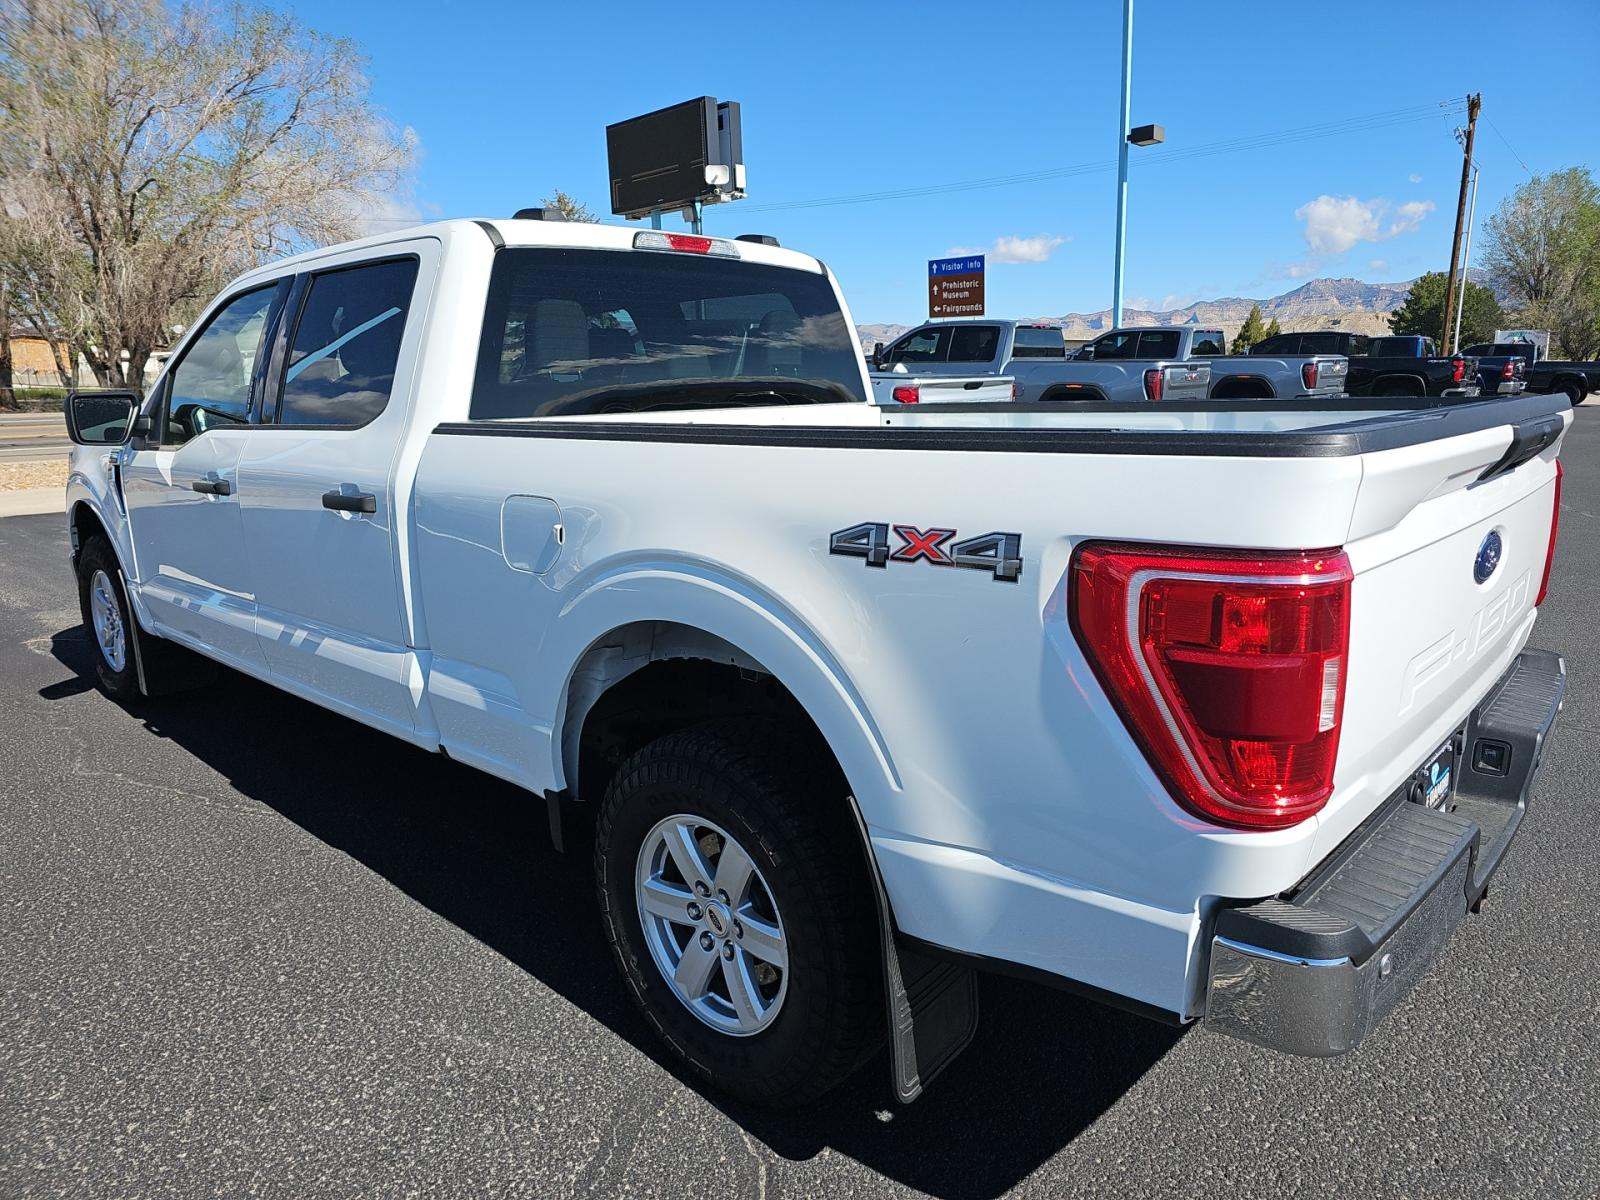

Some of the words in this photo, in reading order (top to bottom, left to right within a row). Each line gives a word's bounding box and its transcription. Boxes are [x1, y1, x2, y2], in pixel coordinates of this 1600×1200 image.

[941, 262, 963, 271] Visitor
[967, 260, 981, 269] Info
[942, 280, 979, 290] Prehistoric
[942, 291, 970, 299] Museum
[942, 303, 983, 314] Fairgrounds
